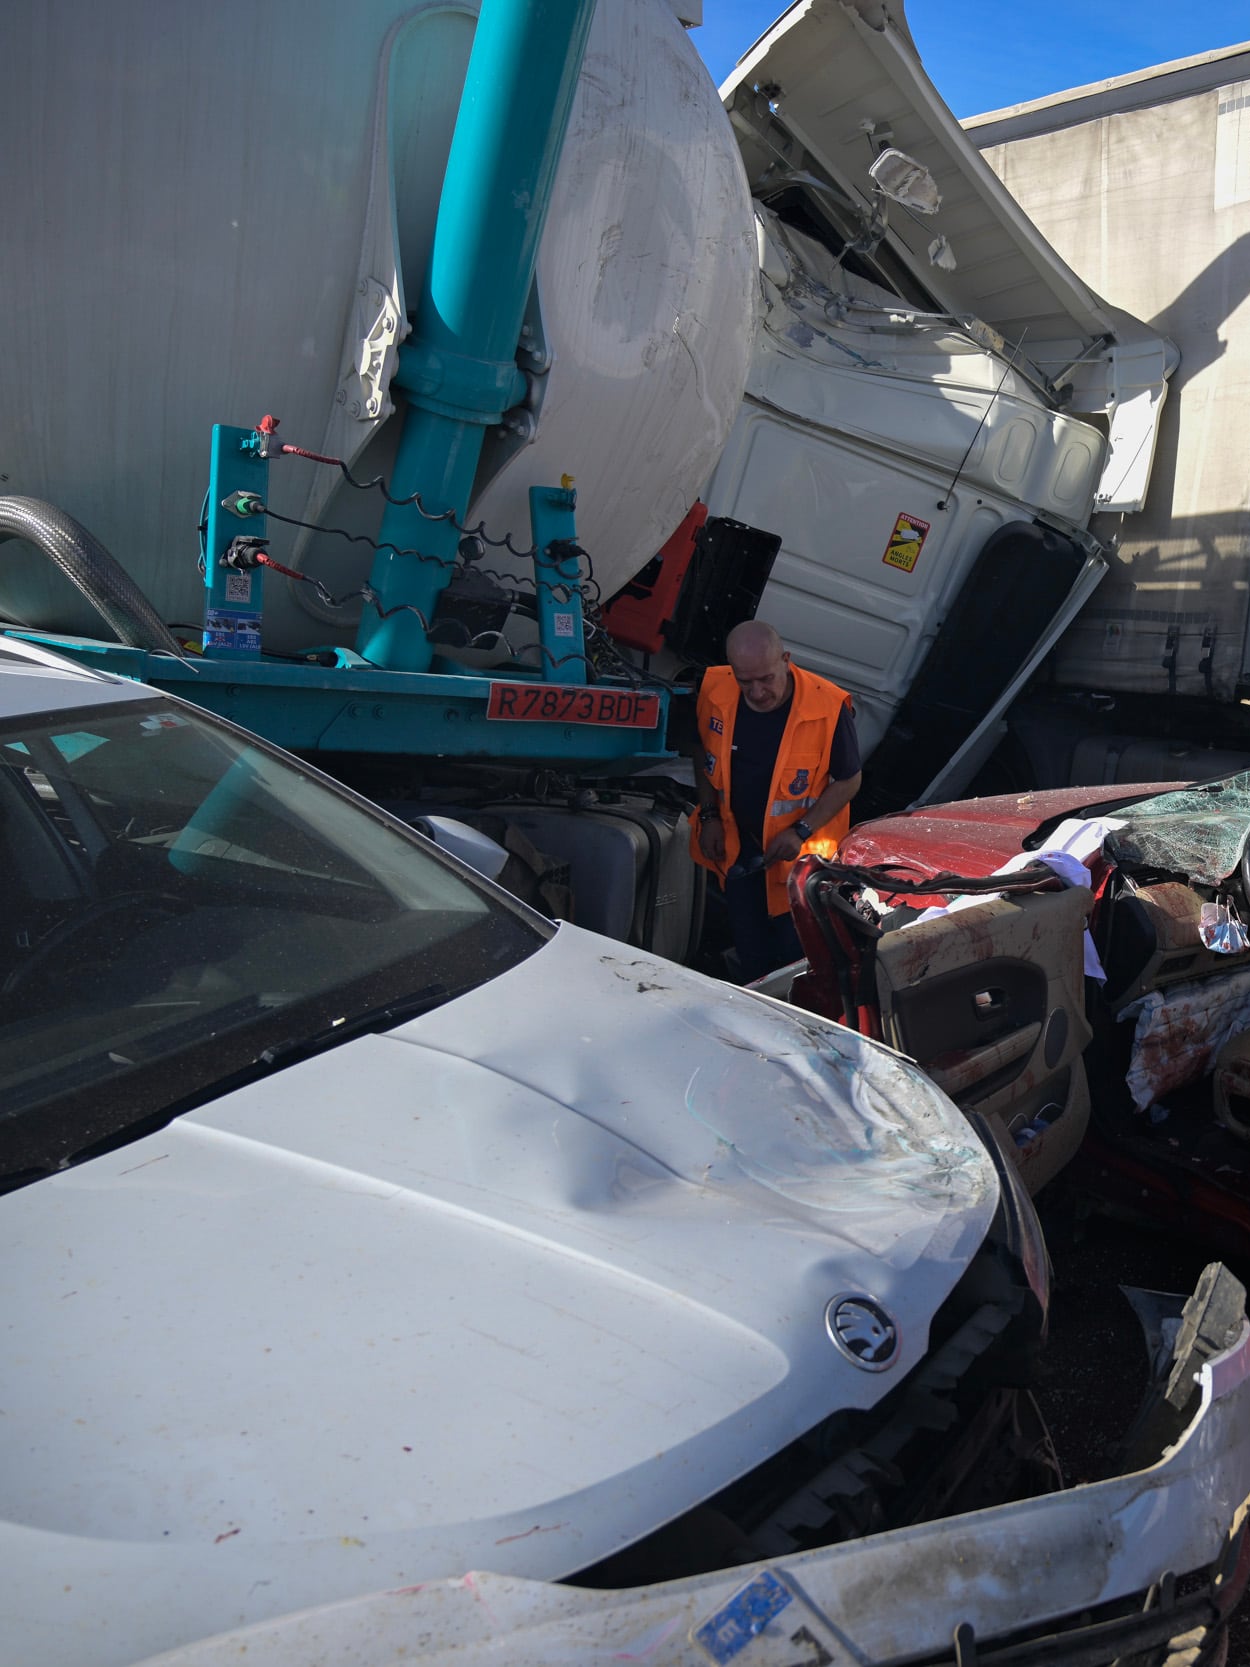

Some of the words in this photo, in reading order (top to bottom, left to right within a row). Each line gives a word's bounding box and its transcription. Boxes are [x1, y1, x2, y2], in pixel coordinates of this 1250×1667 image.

[901, 514, 928, 529] ATTENTION
[890, 556, 909, 567] MORTS
[891, 550, 912, 562] ANGLES
[499, 687, 652, 722] R7873BDF
[712, 719, 723, 732] TE
